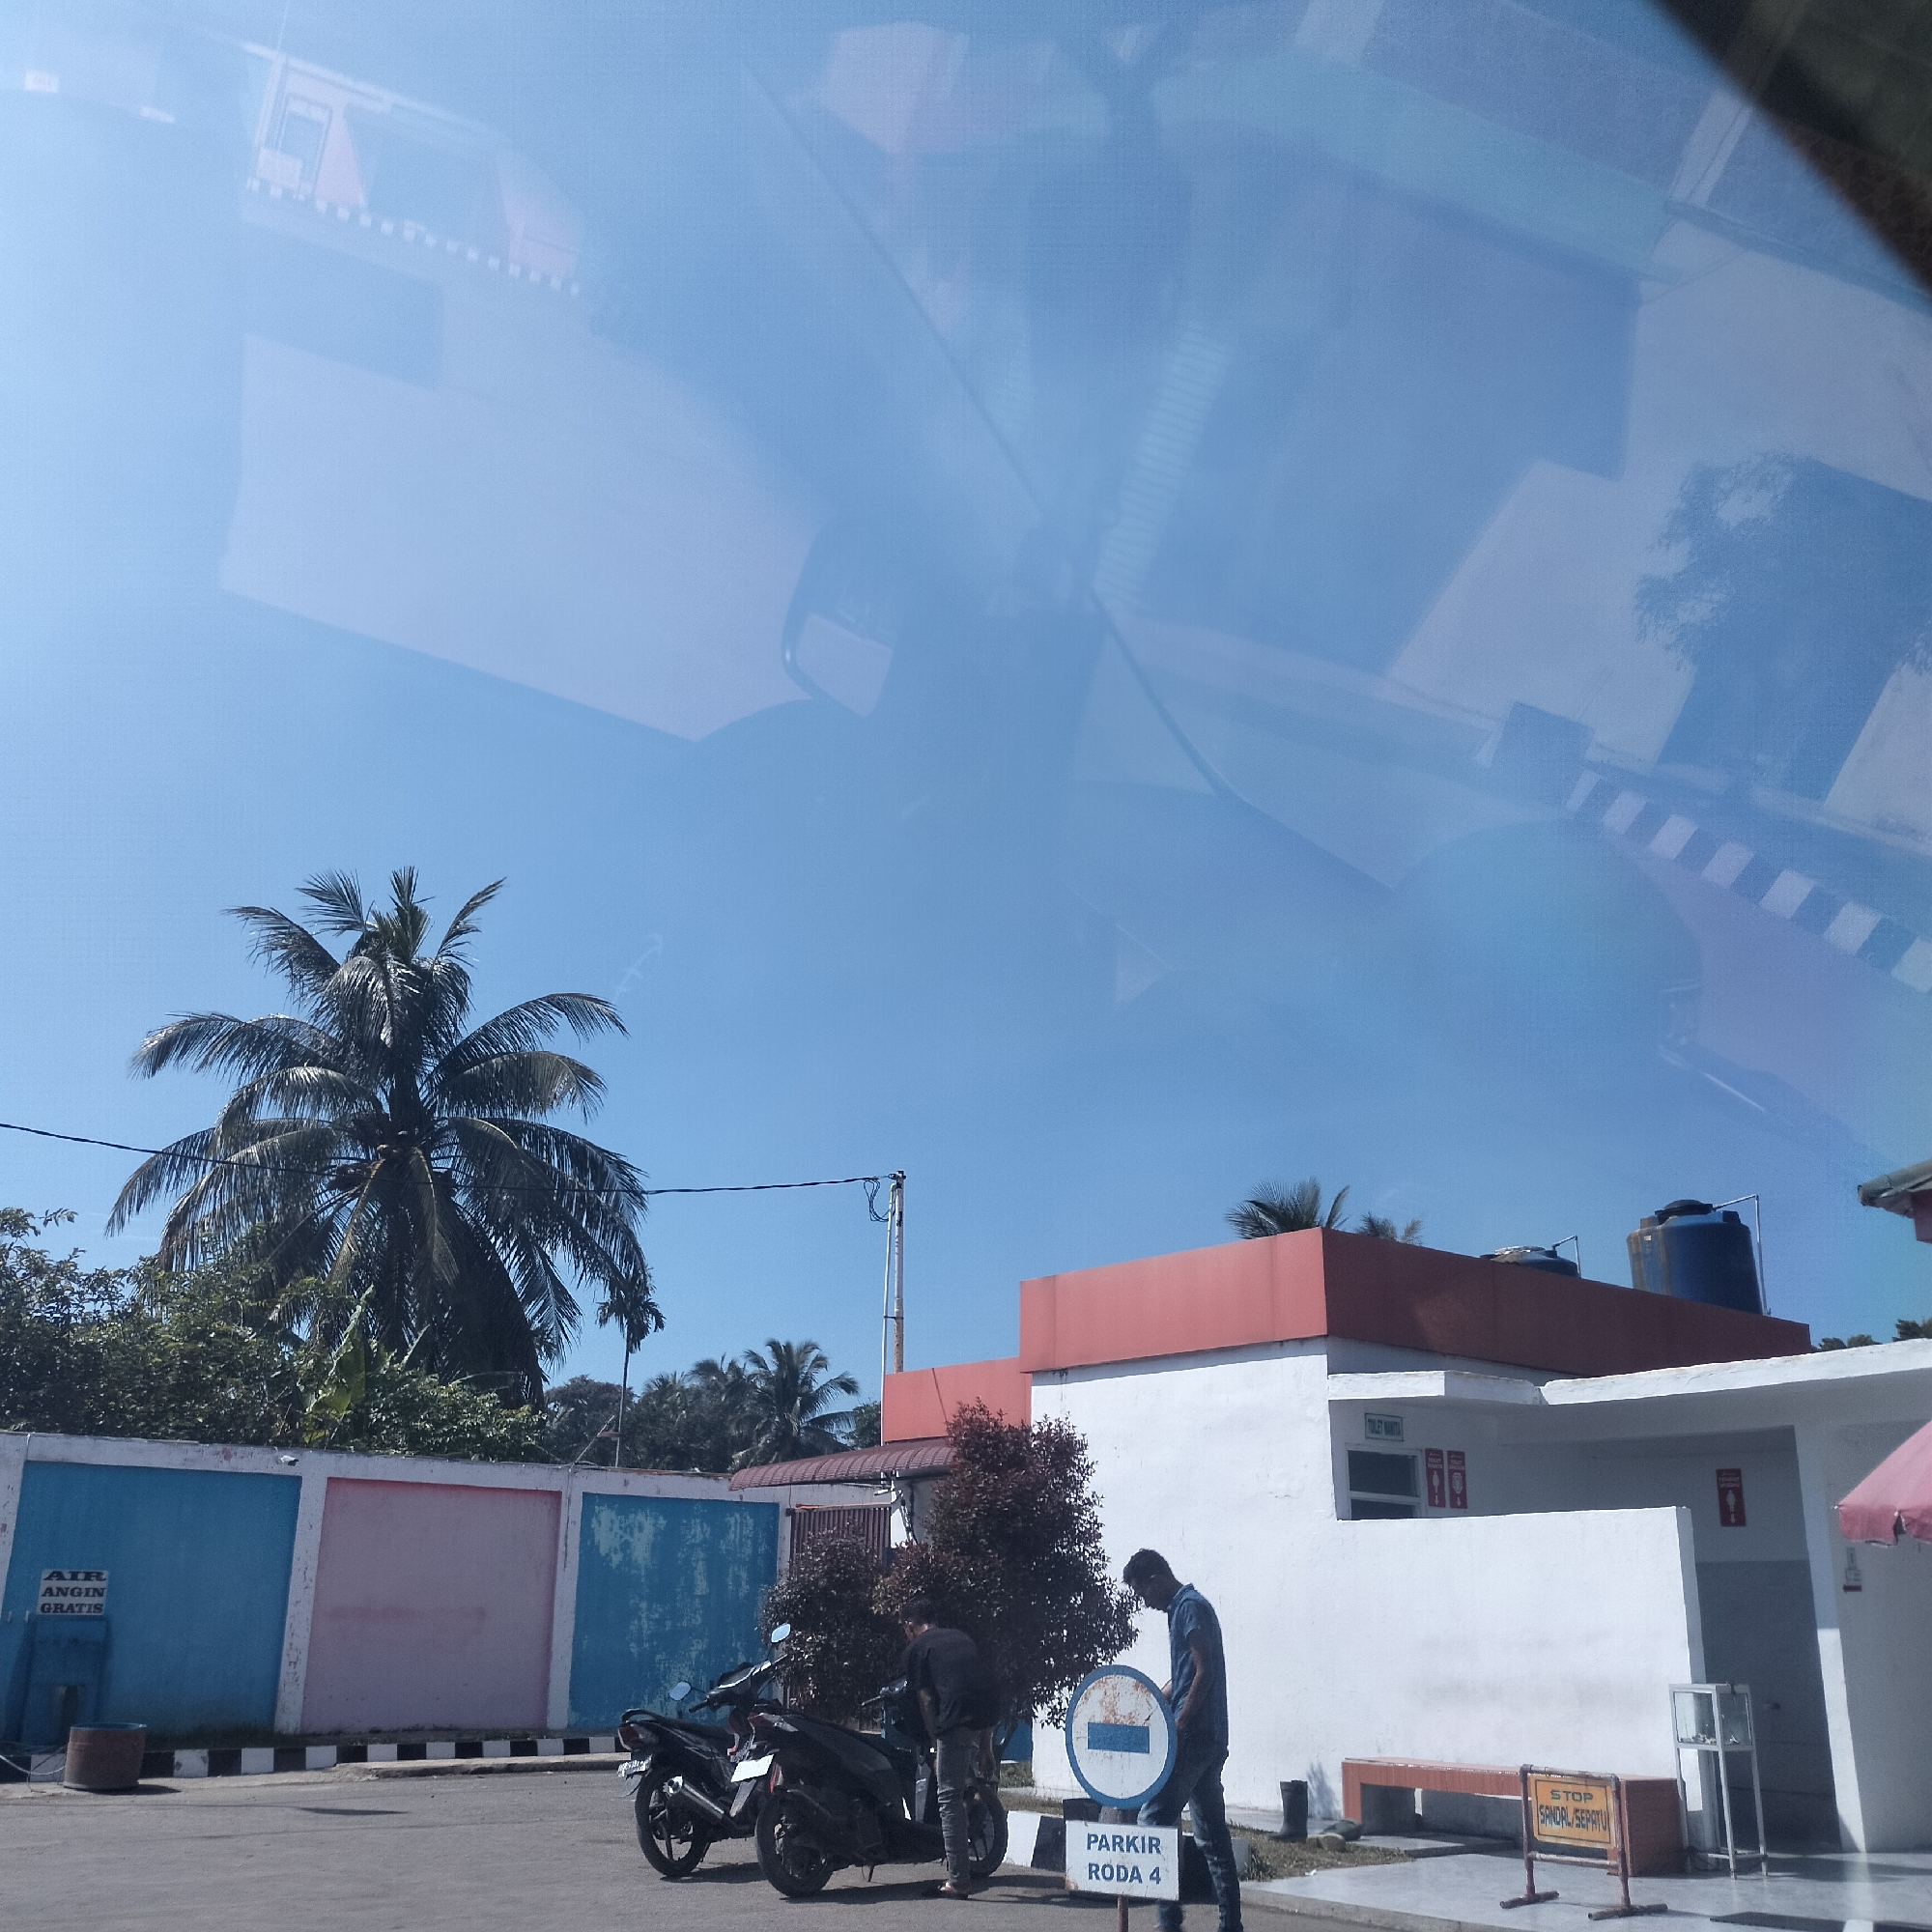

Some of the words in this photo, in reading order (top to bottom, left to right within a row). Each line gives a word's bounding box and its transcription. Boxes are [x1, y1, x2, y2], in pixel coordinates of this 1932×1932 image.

[43, 1570, 107, 1581] AIR
[42, 1586, 106, 1598] ANGIN
[40, 1603, 104, 1614] GRATIS
[1550, 1789, 1594, 1804] STOP
[1087, 1833, 1161, 1855] PARKIR
[1088, 1862, 1143, 1884] RODA
[1149, 1866, 1162, 1885] 4
